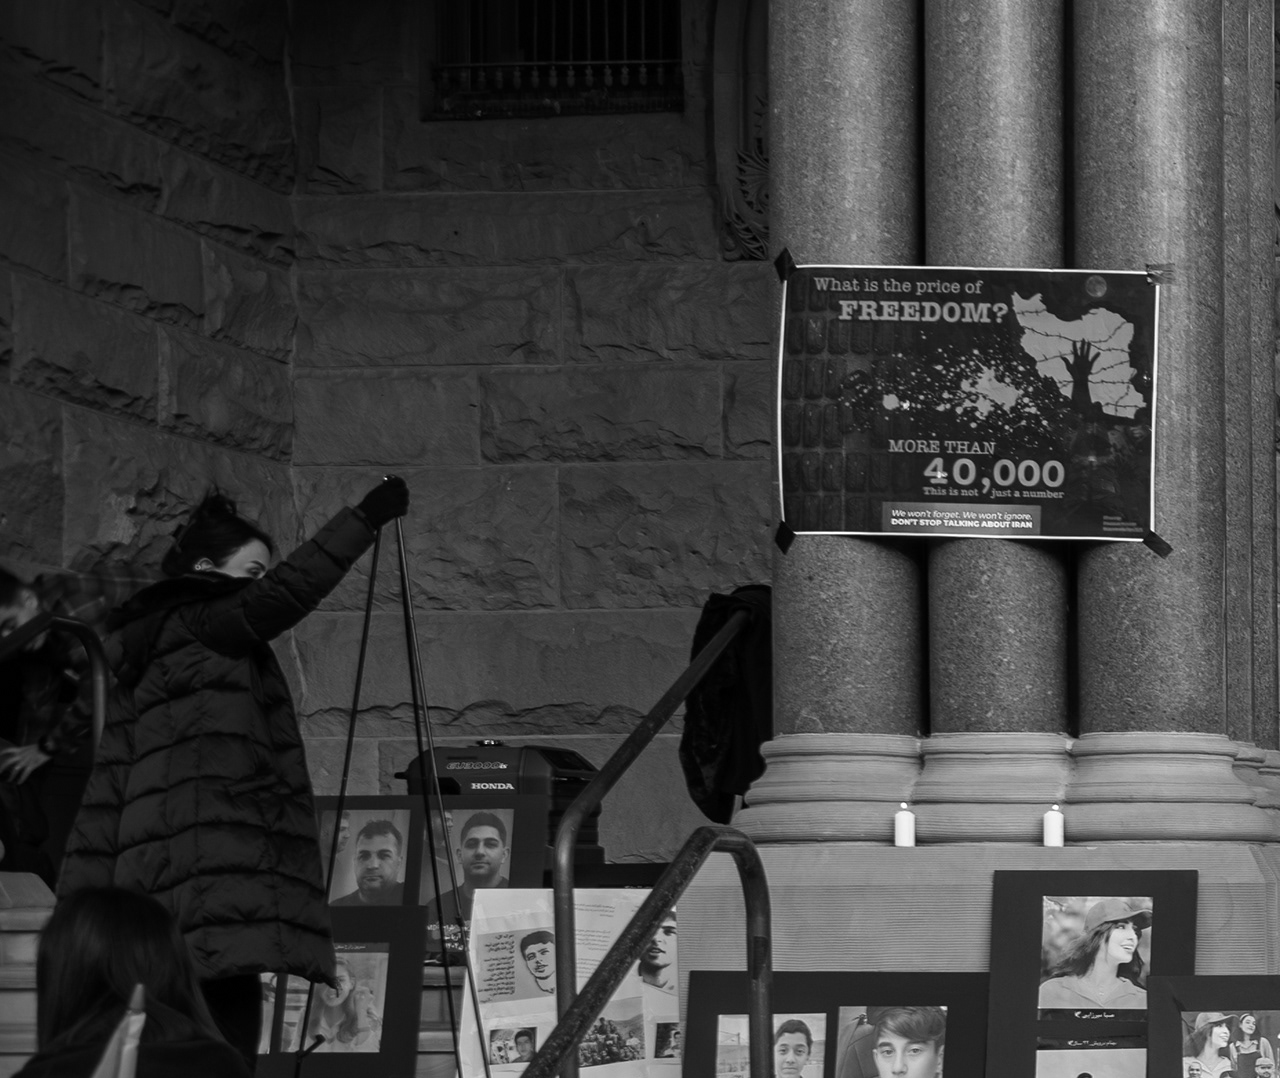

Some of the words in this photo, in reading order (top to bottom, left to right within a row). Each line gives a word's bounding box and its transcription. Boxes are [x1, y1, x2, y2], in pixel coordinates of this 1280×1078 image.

[814, 277, 860, 292] What
[864, 279, 879, 292] is
[883, 278, 912, 292] the
[916, 280, 960, 296] price
[965, 280, 984, 294] of
[838, 300, 1008, 323] FREEDOM?
[888, 439, 940, 453] MORE
[944, 440, 996, 455] THAN
[923, 457, 1065, 493] 40,000
[923, 487, 947, 495] This
[949, 487, 959, 496] is
[990, 488, 1012, 499] just
[1022, 490, 1065, 499] number
[933, 511, 960, 519] forget.
[1004, 512, 1032, 521] ignore.
